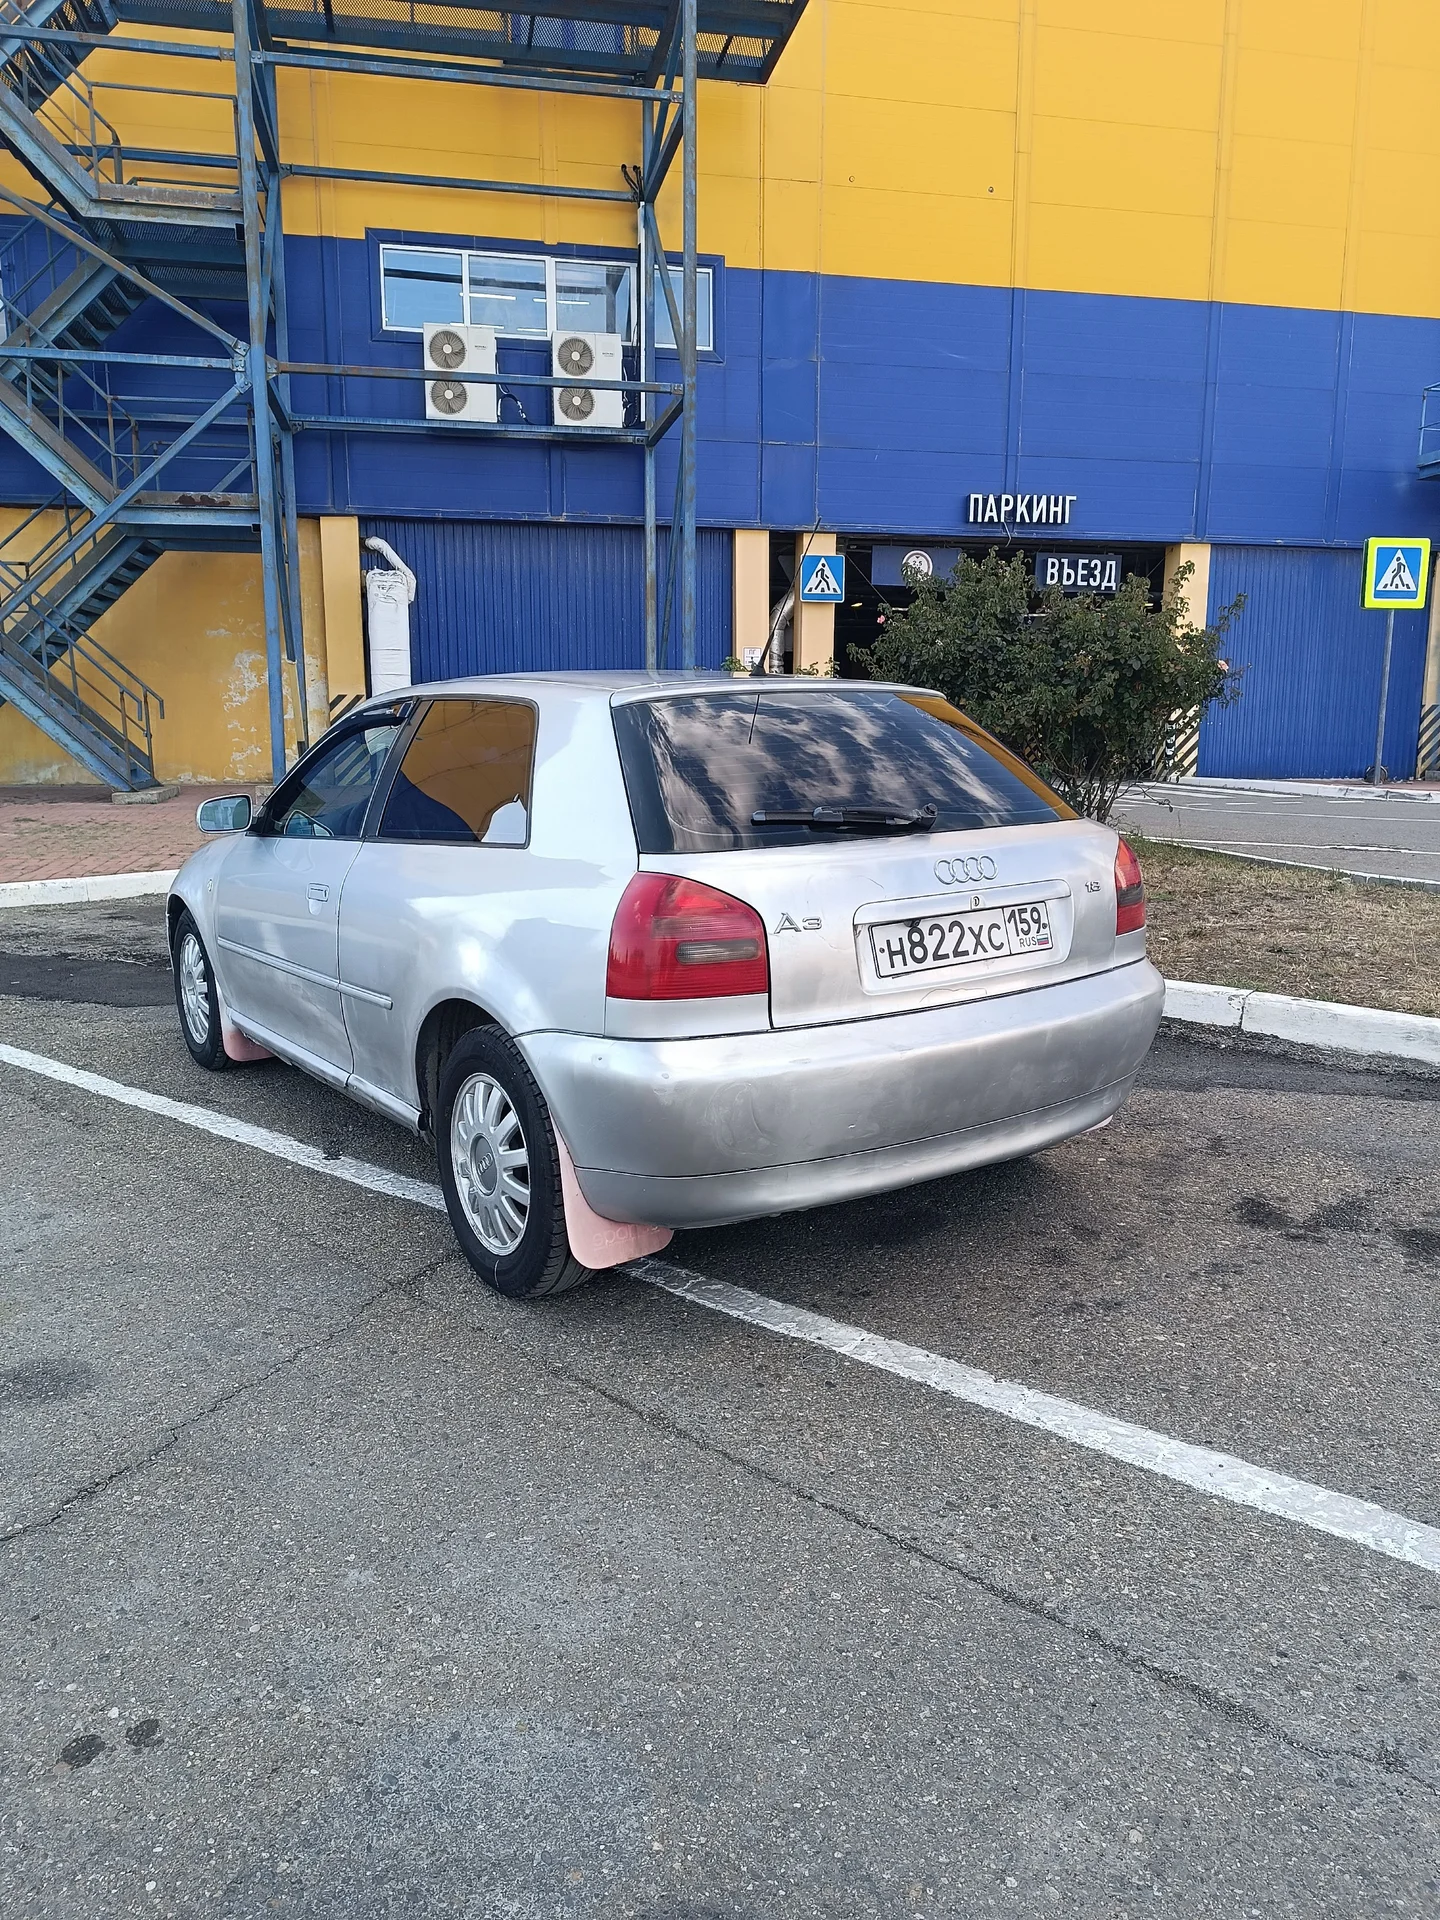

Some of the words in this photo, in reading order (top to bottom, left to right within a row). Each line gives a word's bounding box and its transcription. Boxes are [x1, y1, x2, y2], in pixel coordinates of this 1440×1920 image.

[969, 493, 1077, 524] ПАРКИНГ
[1046, 557, 1117, 591] ВЪЕЗД
[774, 912, 822, 934] A3
[886, 920, 1004, 968] Н822ХС
[1007, 906, 1043, 937] 159
[1019, 937, 1037, 948] RUS
